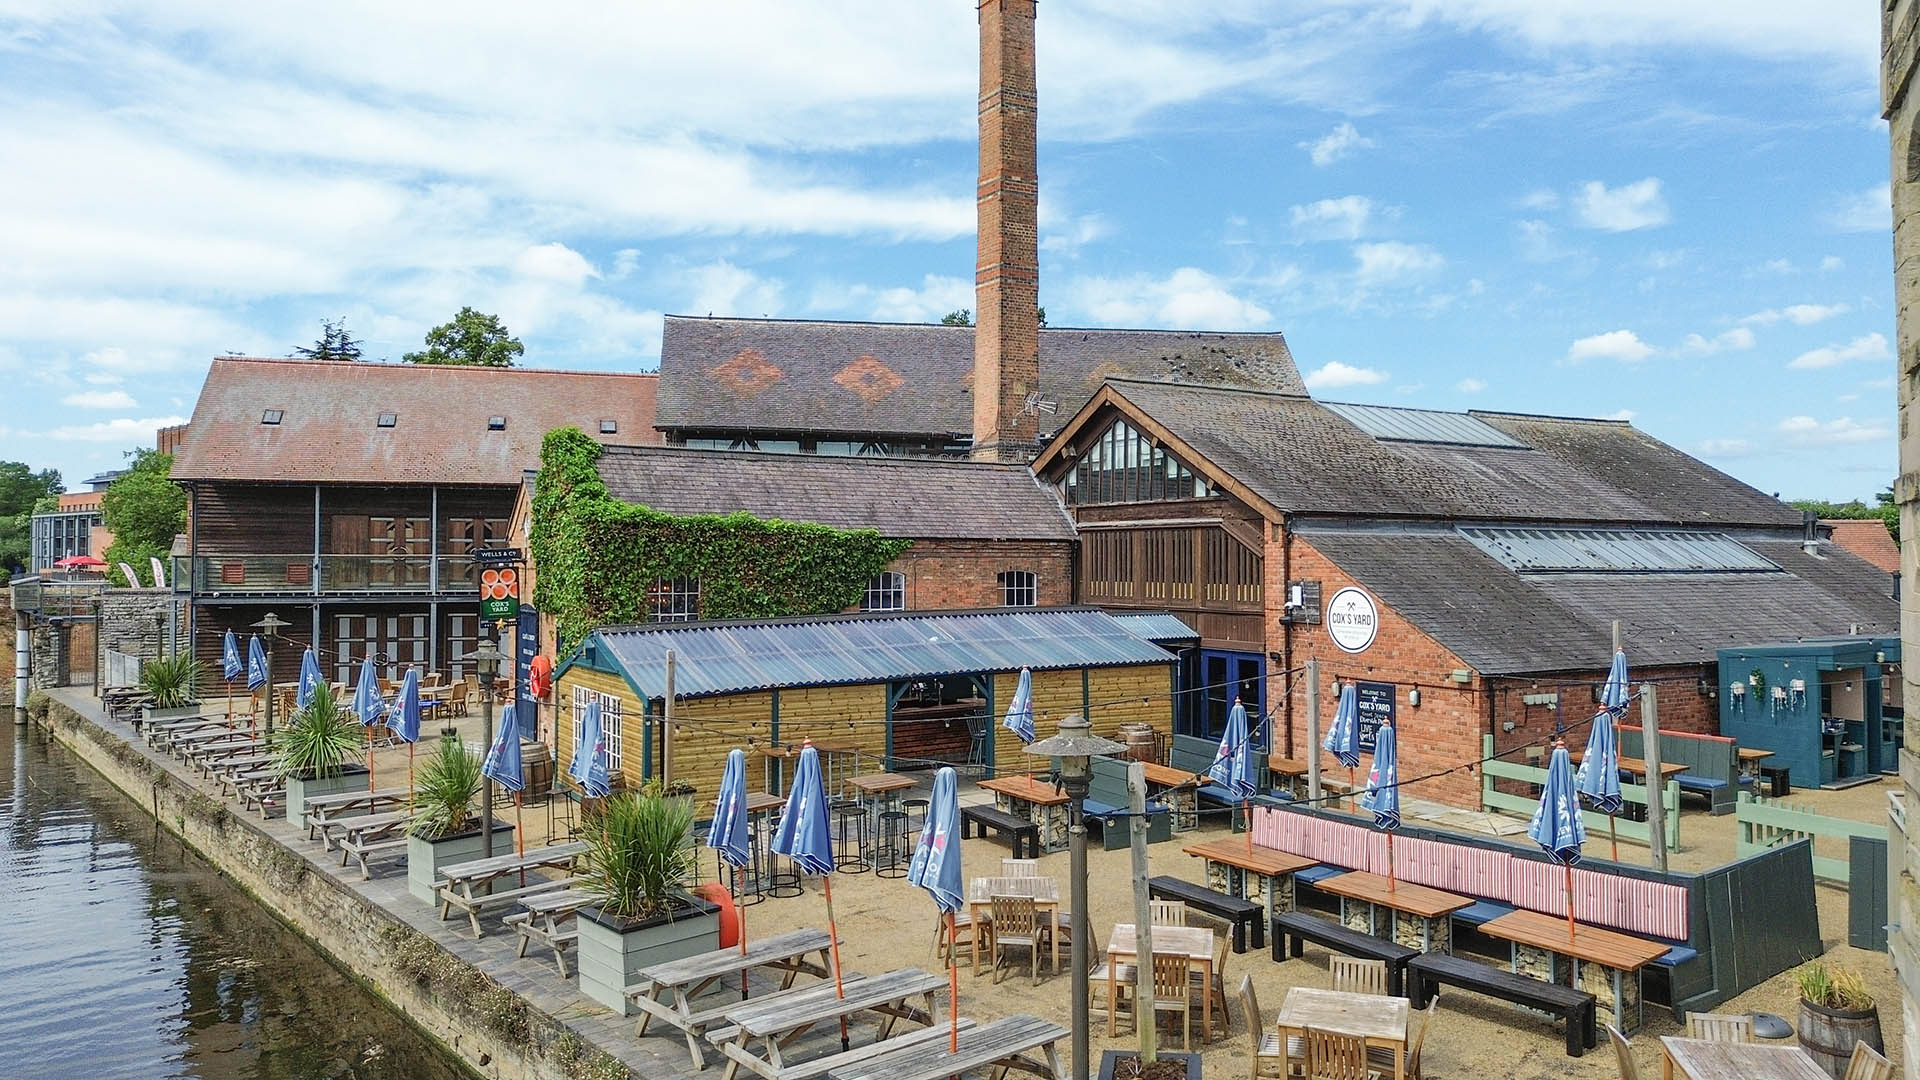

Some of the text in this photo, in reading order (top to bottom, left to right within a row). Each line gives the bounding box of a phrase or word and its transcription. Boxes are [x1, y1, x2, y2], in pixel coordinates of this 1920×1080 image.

[1332, 612, 1371, 626] COX'S YARD
[1359, 701, 1390, 712] COX'S YARD
